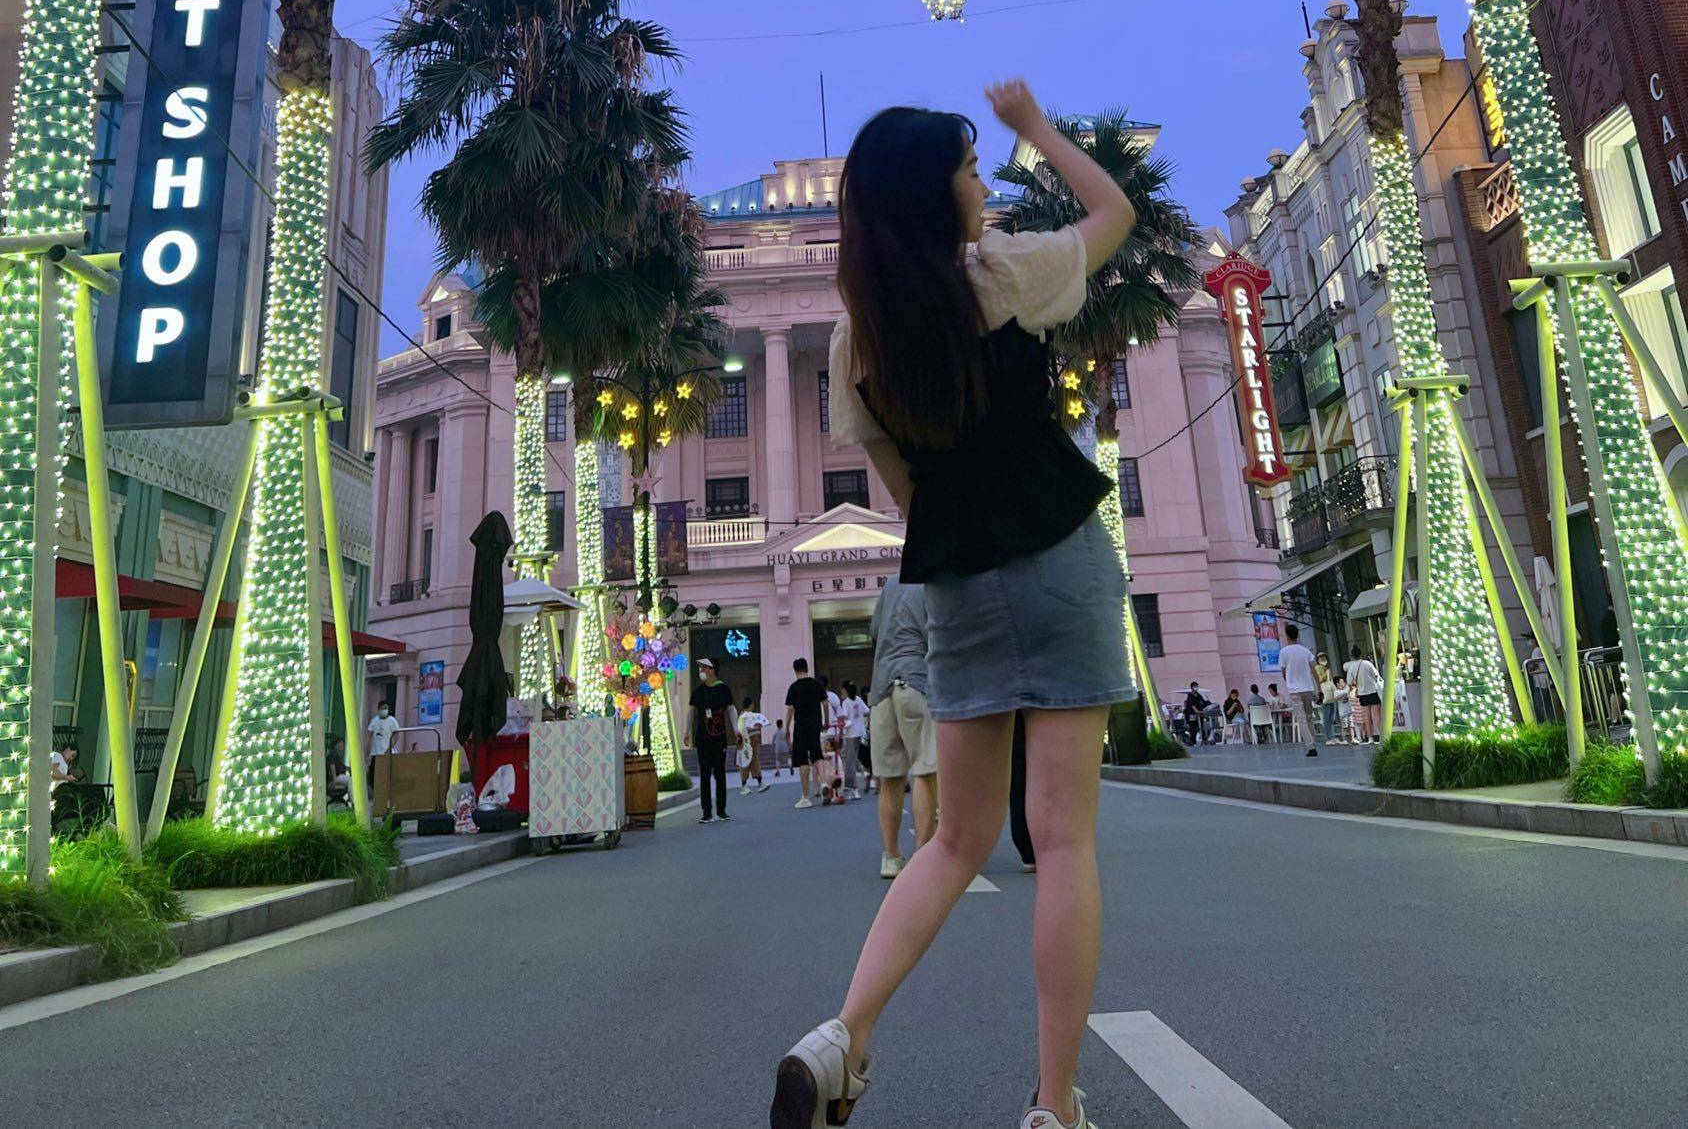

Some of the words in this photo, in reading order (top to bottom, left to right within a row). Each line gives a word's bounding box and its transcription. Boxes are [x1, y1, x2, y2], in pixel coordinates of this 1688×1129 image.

[136, 86, 211, 363] SHOP
[1215, 261, 1259, 278] CLARIDGE
[1233, 286, 1276, 475] STARLIGHT
[767, 552, 810, 567] HUAYI
[820, 549, 869, 562] GRAND
[812, 576, 888, 592] 巨星影院
